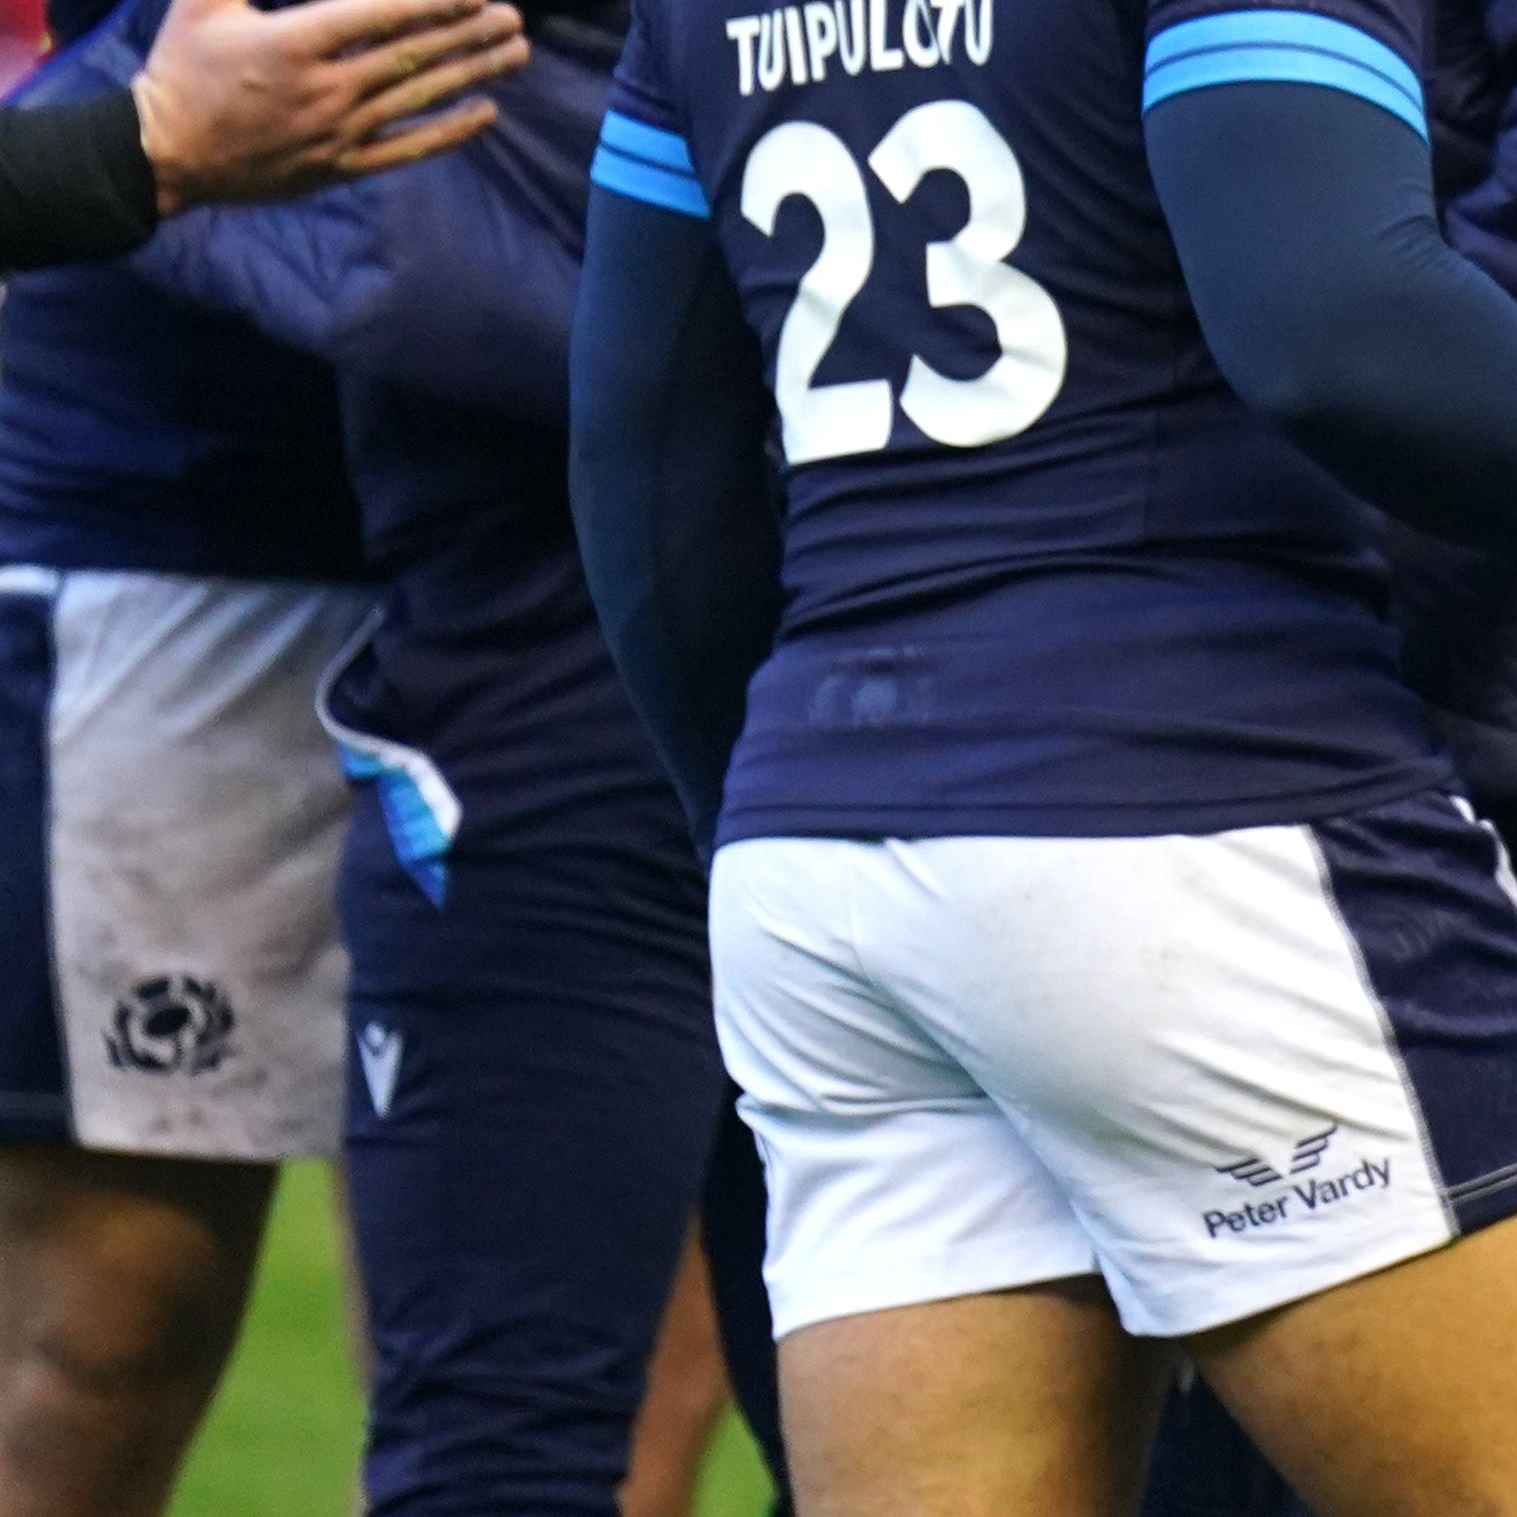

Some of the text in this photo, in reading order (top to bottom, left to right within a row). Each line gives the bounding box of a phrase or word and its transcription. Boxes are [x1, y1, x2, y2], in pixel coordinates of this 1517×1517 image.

[740, 100, 1067, 464] 23
[1202, 1156, 1391, 1239] Peter Vardy
